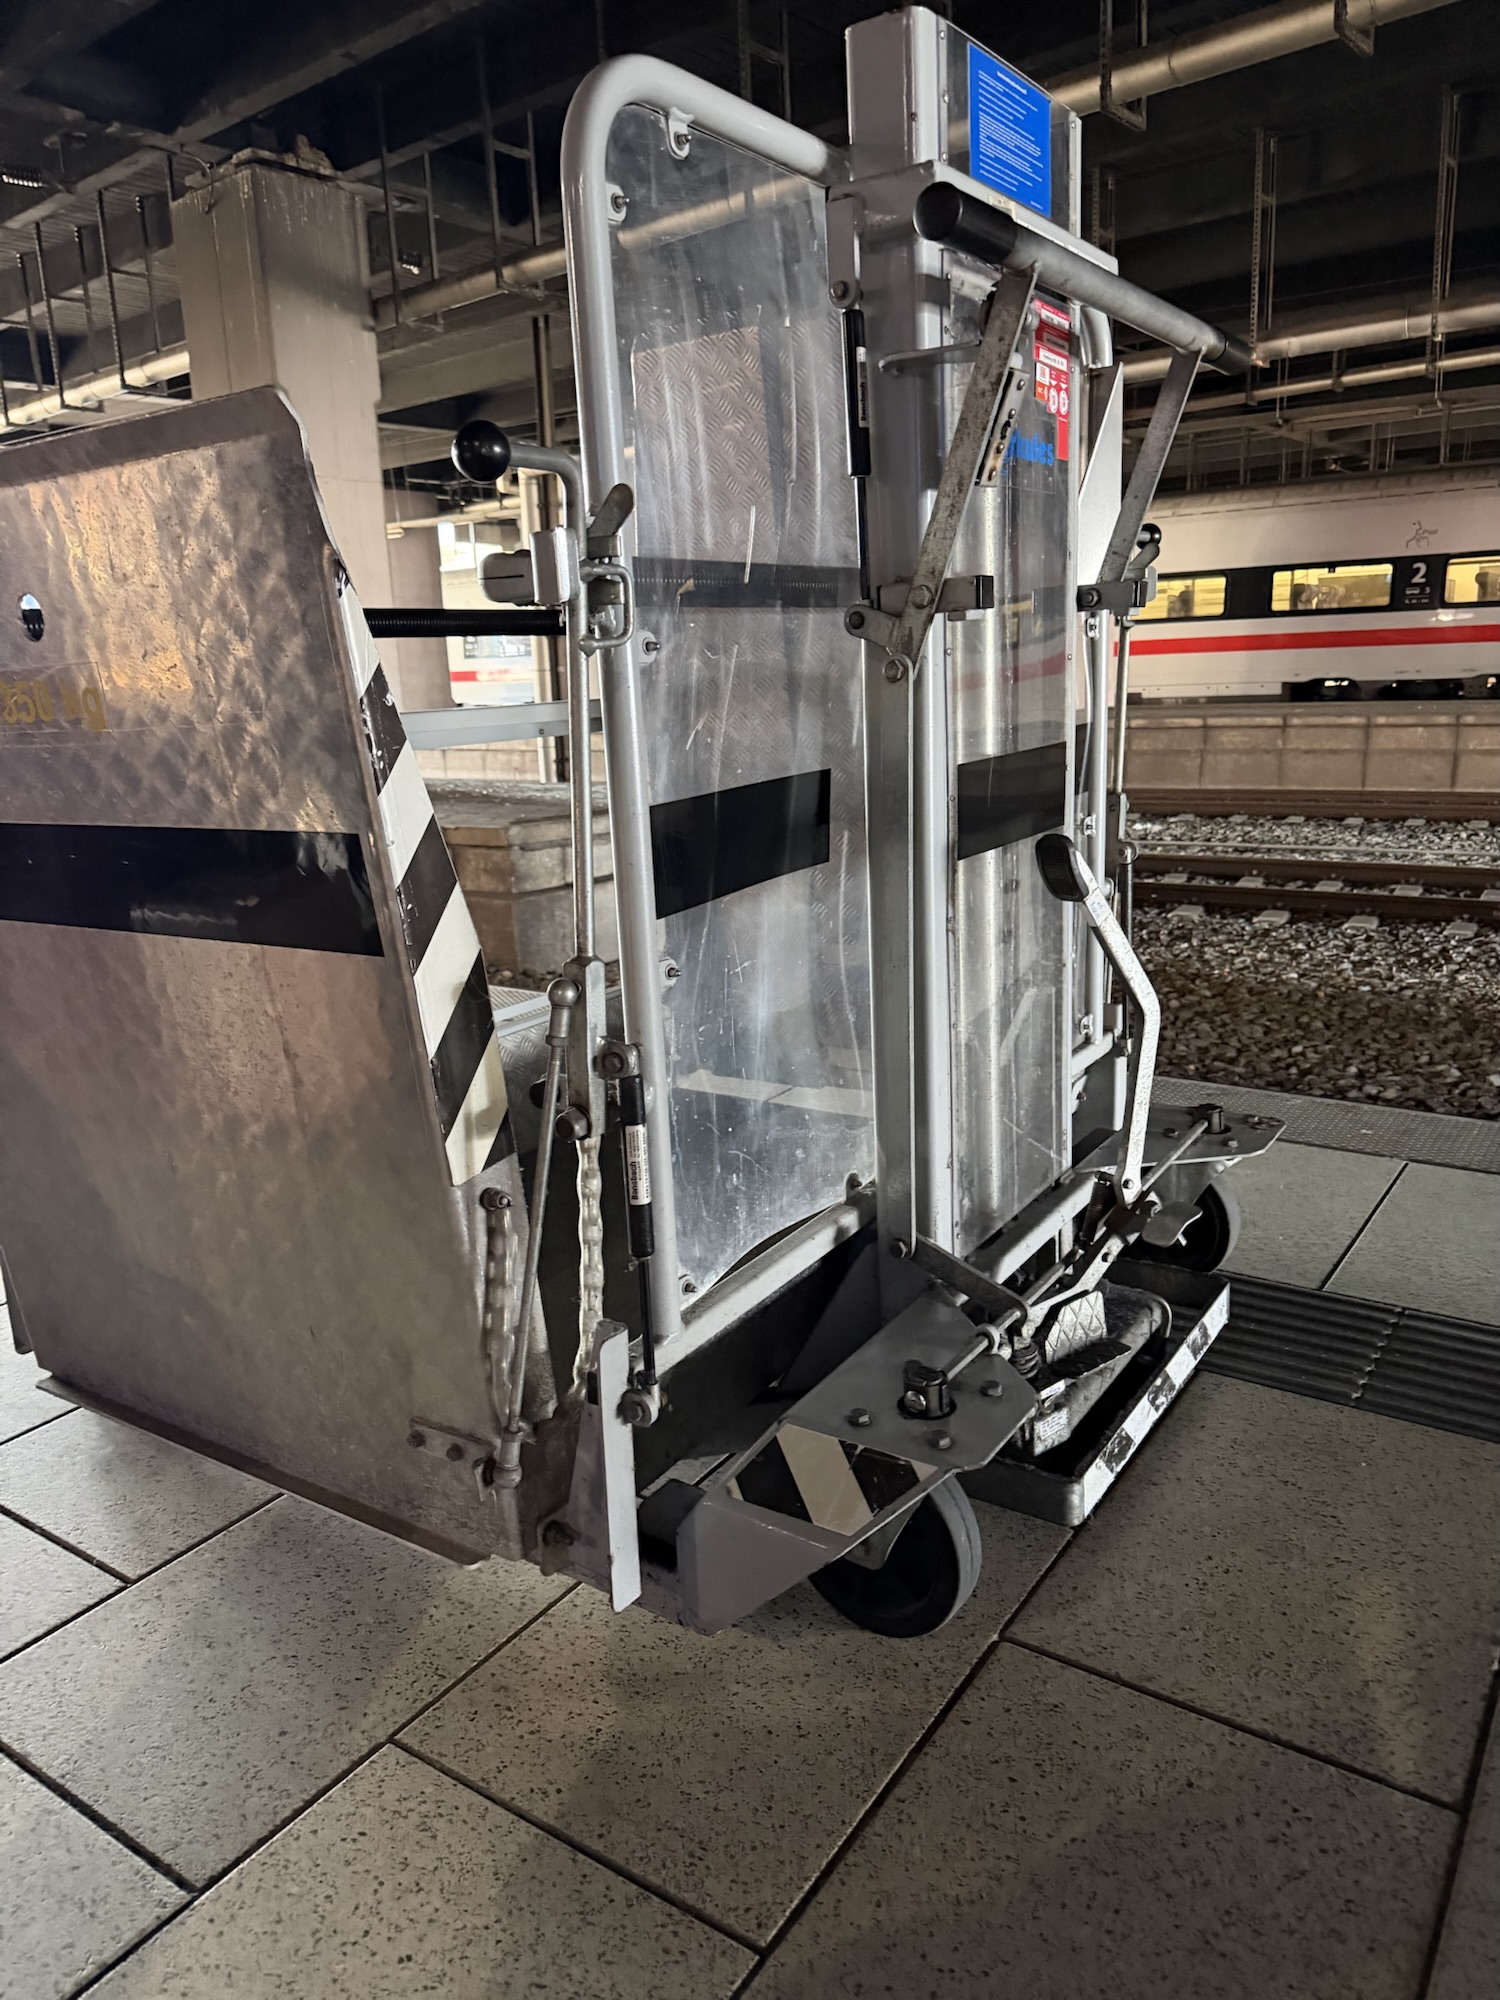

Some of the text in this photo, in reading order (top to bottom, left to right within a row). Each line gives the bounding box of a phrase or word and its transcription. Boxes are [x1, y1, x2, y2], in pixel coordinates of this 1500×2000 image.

[1007, 428, 1054, 467] rkules
[1411, 562, 1427, 583] 2
[630, 1161, 638, 1200] Bansbach
